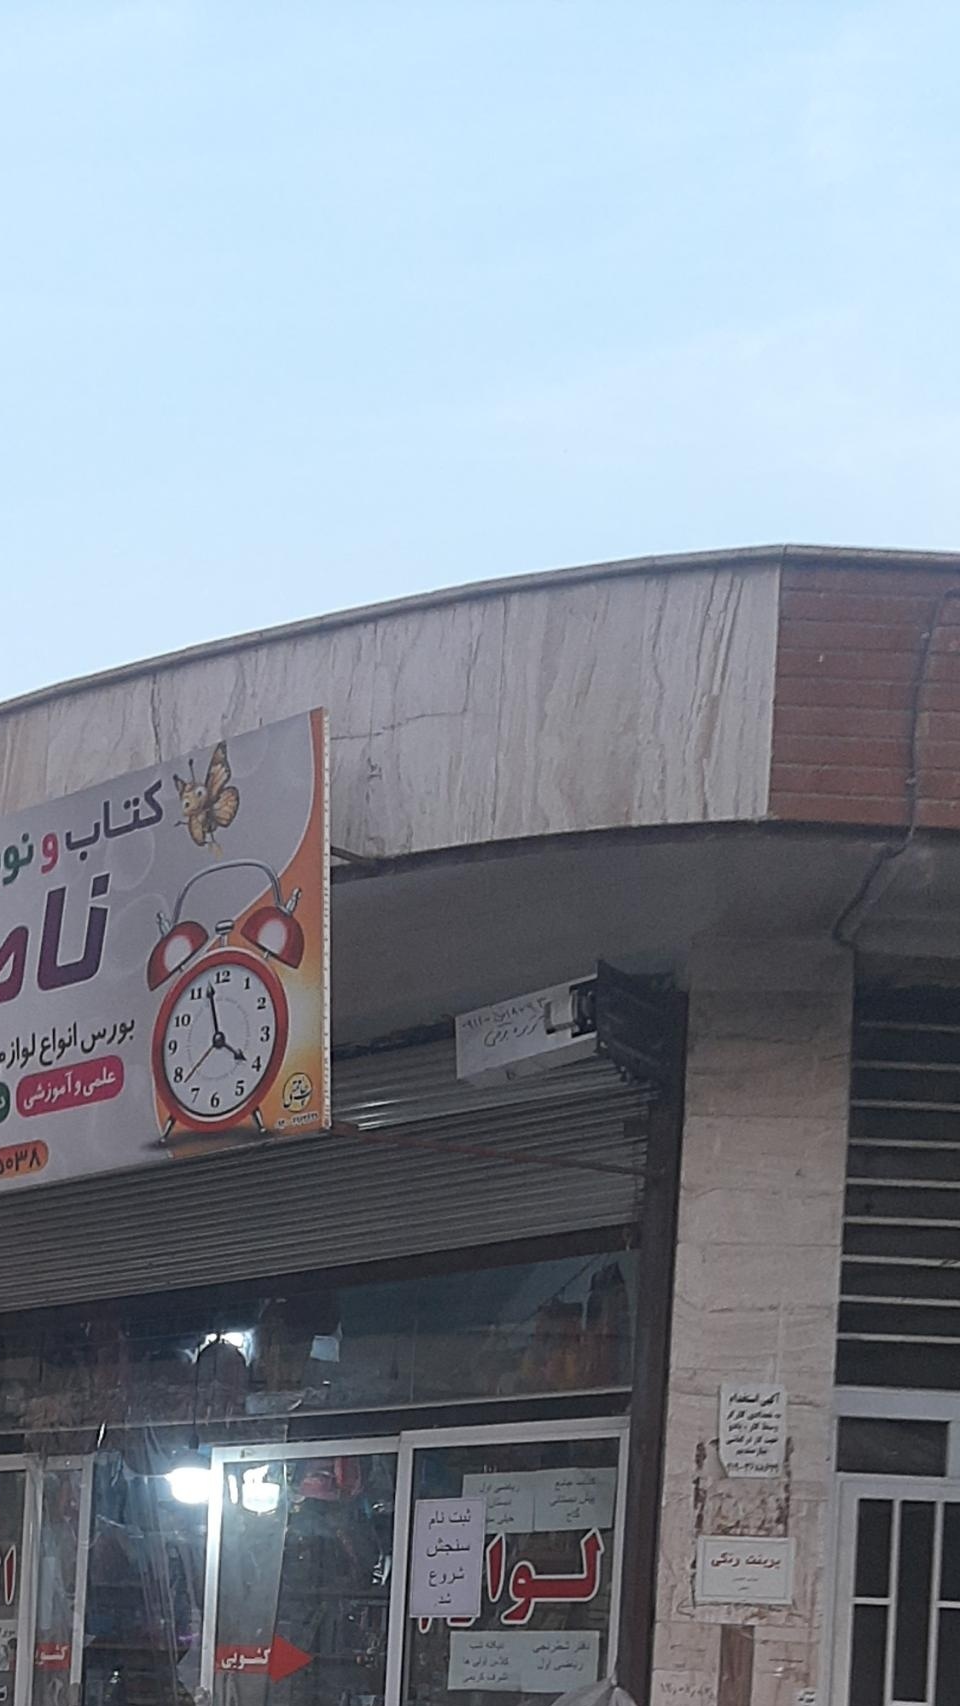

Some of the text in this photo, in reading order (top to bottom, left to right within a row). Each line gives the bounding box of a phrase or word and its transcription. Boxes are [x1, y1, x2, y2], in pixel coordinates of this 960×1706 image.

[65, 779, 163, 861] کتاب
[41, 832, 59, 874] و
[215, 970, 231, 984] 12
[244, 977, 251, 990] 1
[190, 987, 203, 1000] 11
[257, 997, 266, 1010] 2
[174, 1014, 191, 1028] 10
[80, 1019, 135, 1053] بورس
[260, 1026, 270, 1042] 3
[40, 1022, 77, 1066] انواع
[168, 1040, 178, 1055] 9
[252, 1056, 261, 1072] 4
[173, 1067, 183, 1083] 8
[23, 1067, 116, 1110] علمی و آموزشی
[191, 1087, 201, 1103] 7
[235, 1080, 245, 1097] 5
[210, 1092, 220, 1108] 6
[428, 1510, 445, 1530] نام
[449, 1508, 471, 1527] ثبت
[426, 1537, 471, 1557] سنجش
[710, 1551, 782, 1569] پرینت رنگی
[428, 1566, 465, 1587] شروع
[221, 1647, 271, 1669] کشویی
